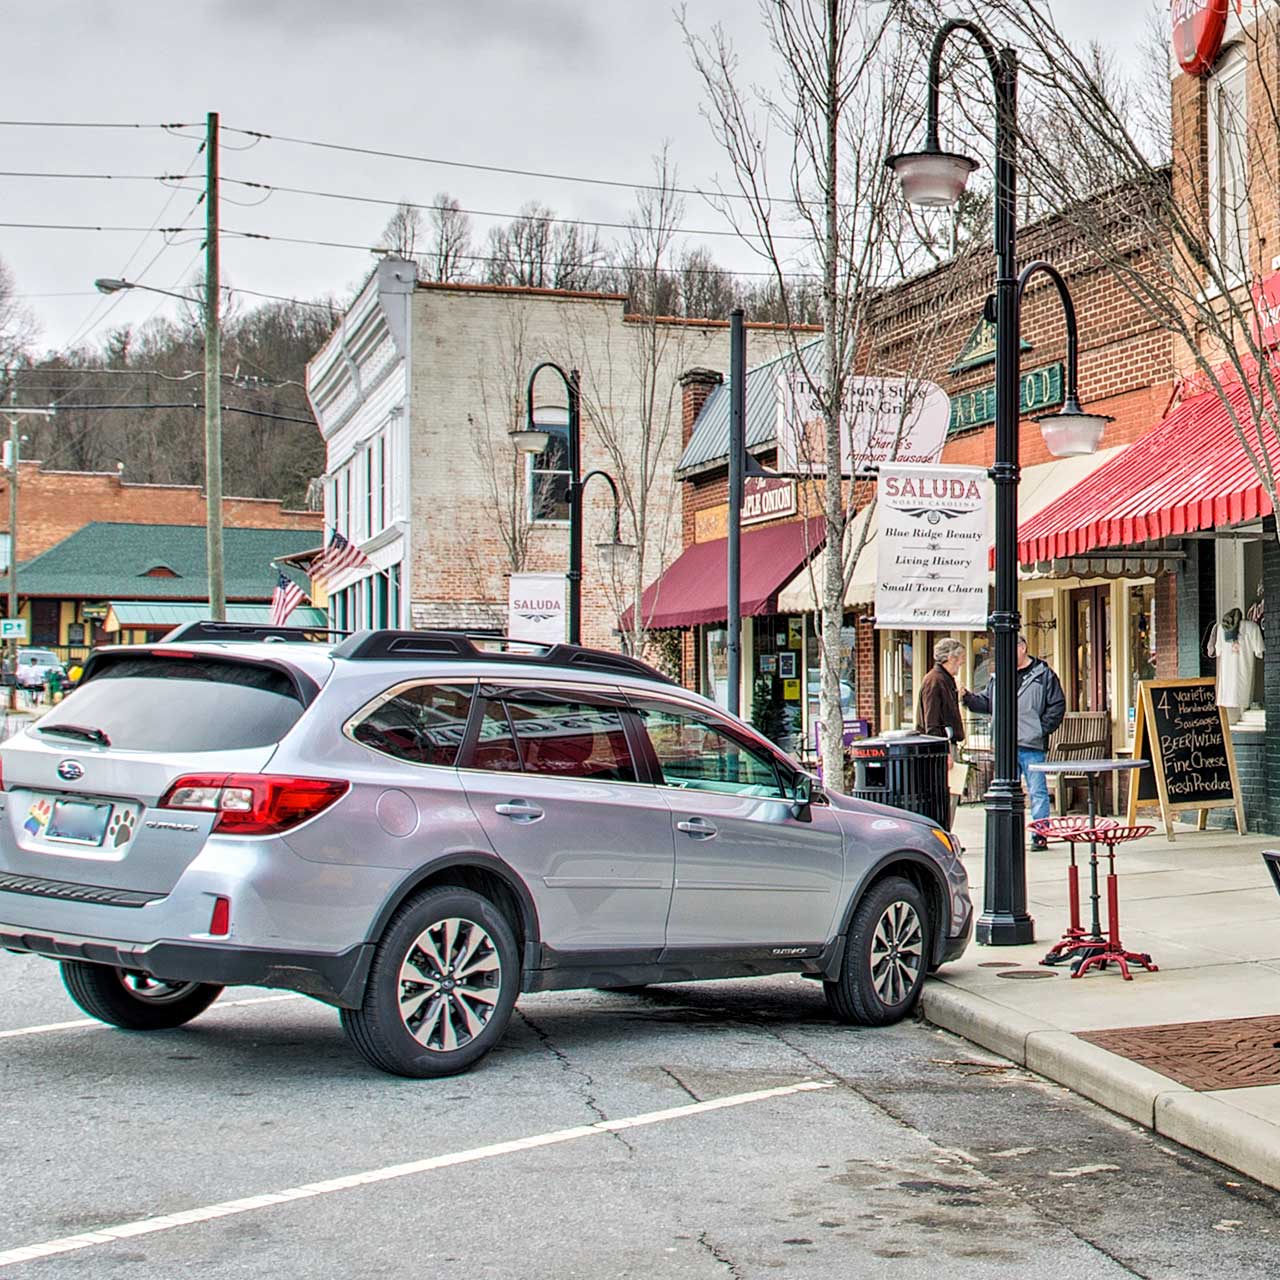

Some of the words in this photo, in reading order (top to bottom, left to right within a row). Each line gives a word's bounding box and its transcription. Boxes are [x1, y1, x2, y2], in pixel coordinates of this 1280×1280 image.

[884, 476, 982, 500] SALUDA
[762, 485, 791, 513] ONION
[928, 500, 976, 508] CAROLINA
[885, 527, 910, 538] Blue
[912, 528, 943, 540] Ridge
[945, 529, 983, 542] Beauty
[895, 555, 929, 567] Living
[932, 556, 973, 569] History
[880, 582, 912, 593] Small
[915, 583, 944, 593] Town
[947, 584, 984, 594] Charm
[513, 599, 561, 610] SALUDA
[912, 607, 930, 617] Est.
[3, 623, 14, 635] P
[1157, 690, 1171, 720] 4
[1174, 715, 1220, 733] Sausages
[1161, 729, 1222, 755] BEER/WINE
[1164, 754, 1193, 774] Fine
[1191, 751, 1227, 769] Cheese
[1167, 776, 1194, 796] Fresh
[1191, 772, 1231, 792] Produce
